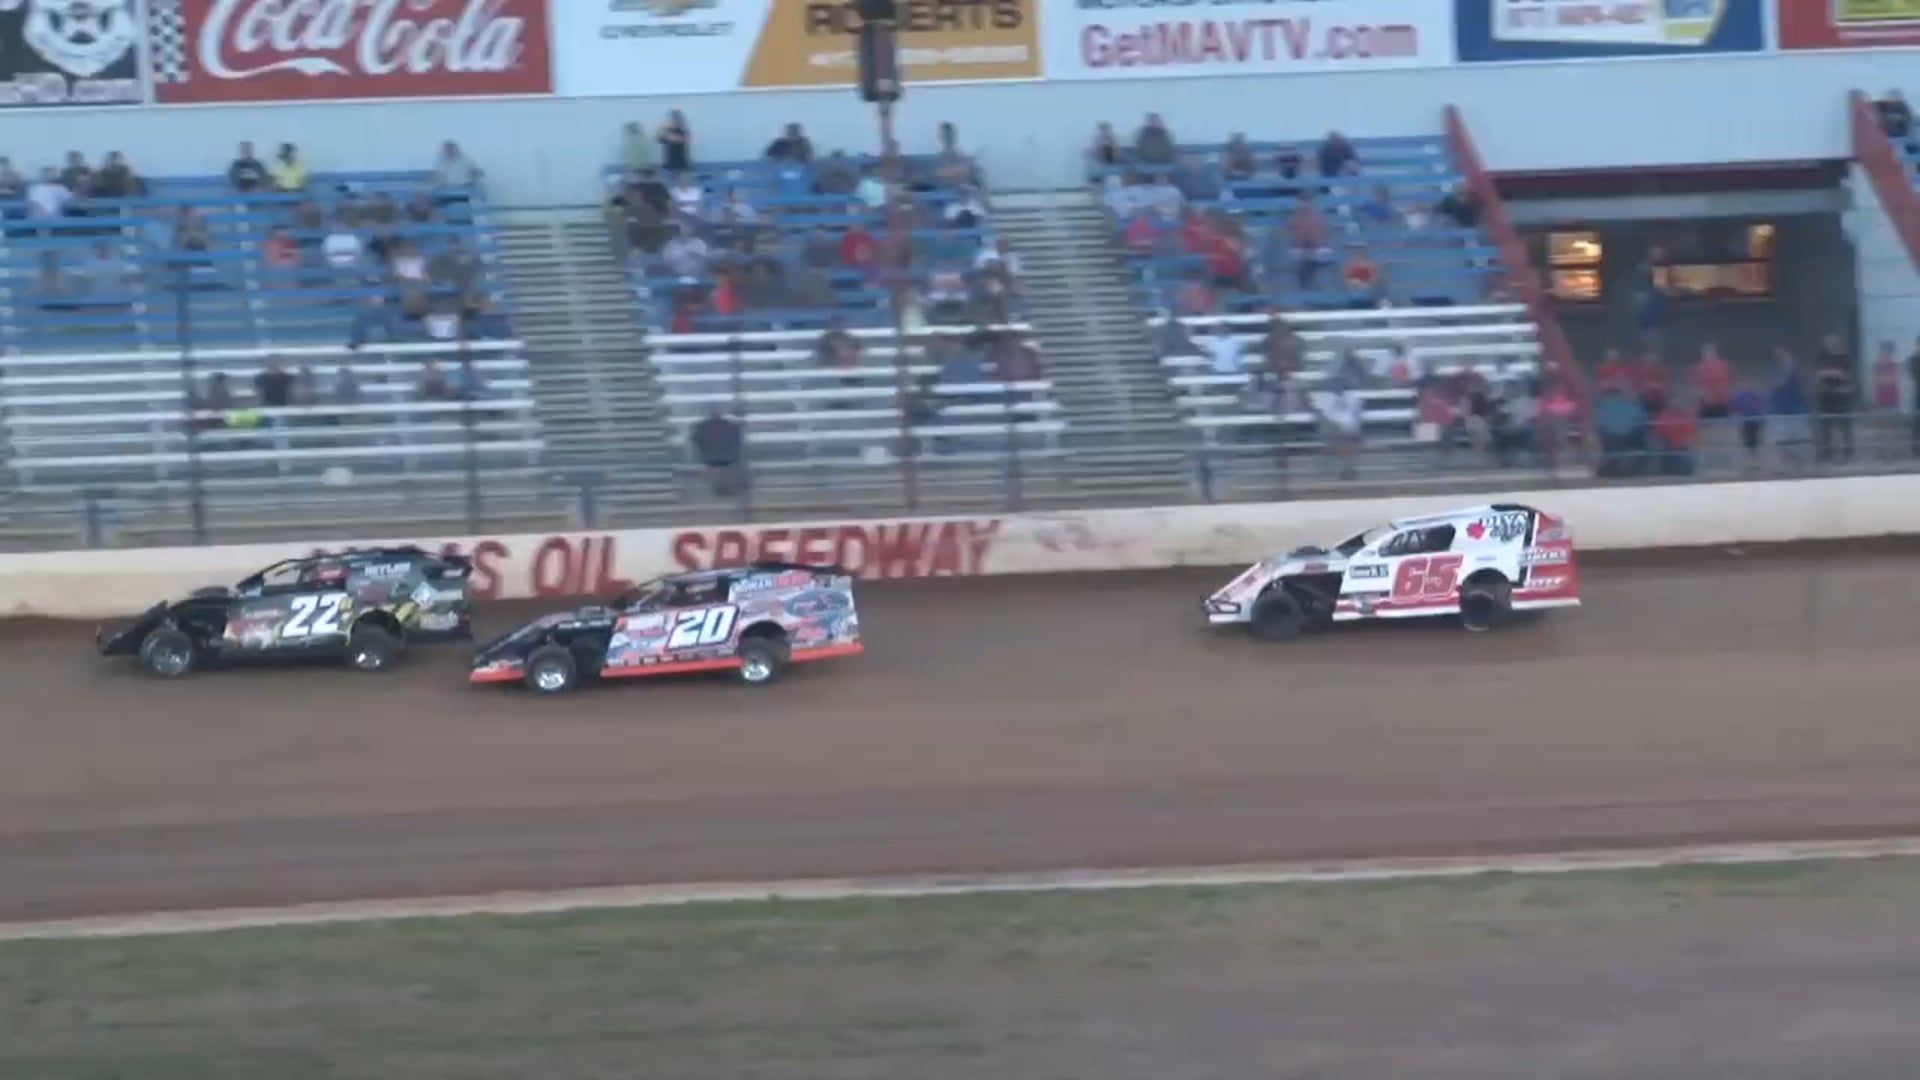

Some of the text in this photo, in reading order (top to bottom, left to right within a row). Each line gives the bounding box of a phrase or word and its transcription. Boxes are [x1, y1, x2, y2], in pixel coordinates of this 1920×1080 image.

[1081, 18, 1418, 68] GetMAVTV.com
[531, 536, 636, 599] OIL
[670, 518, 1002, 579] SPEEDWAY
[1394, 555, 1464, 604] 65
[282, 593, 348, 638] 22
[667, 604, 738, 650] 20
